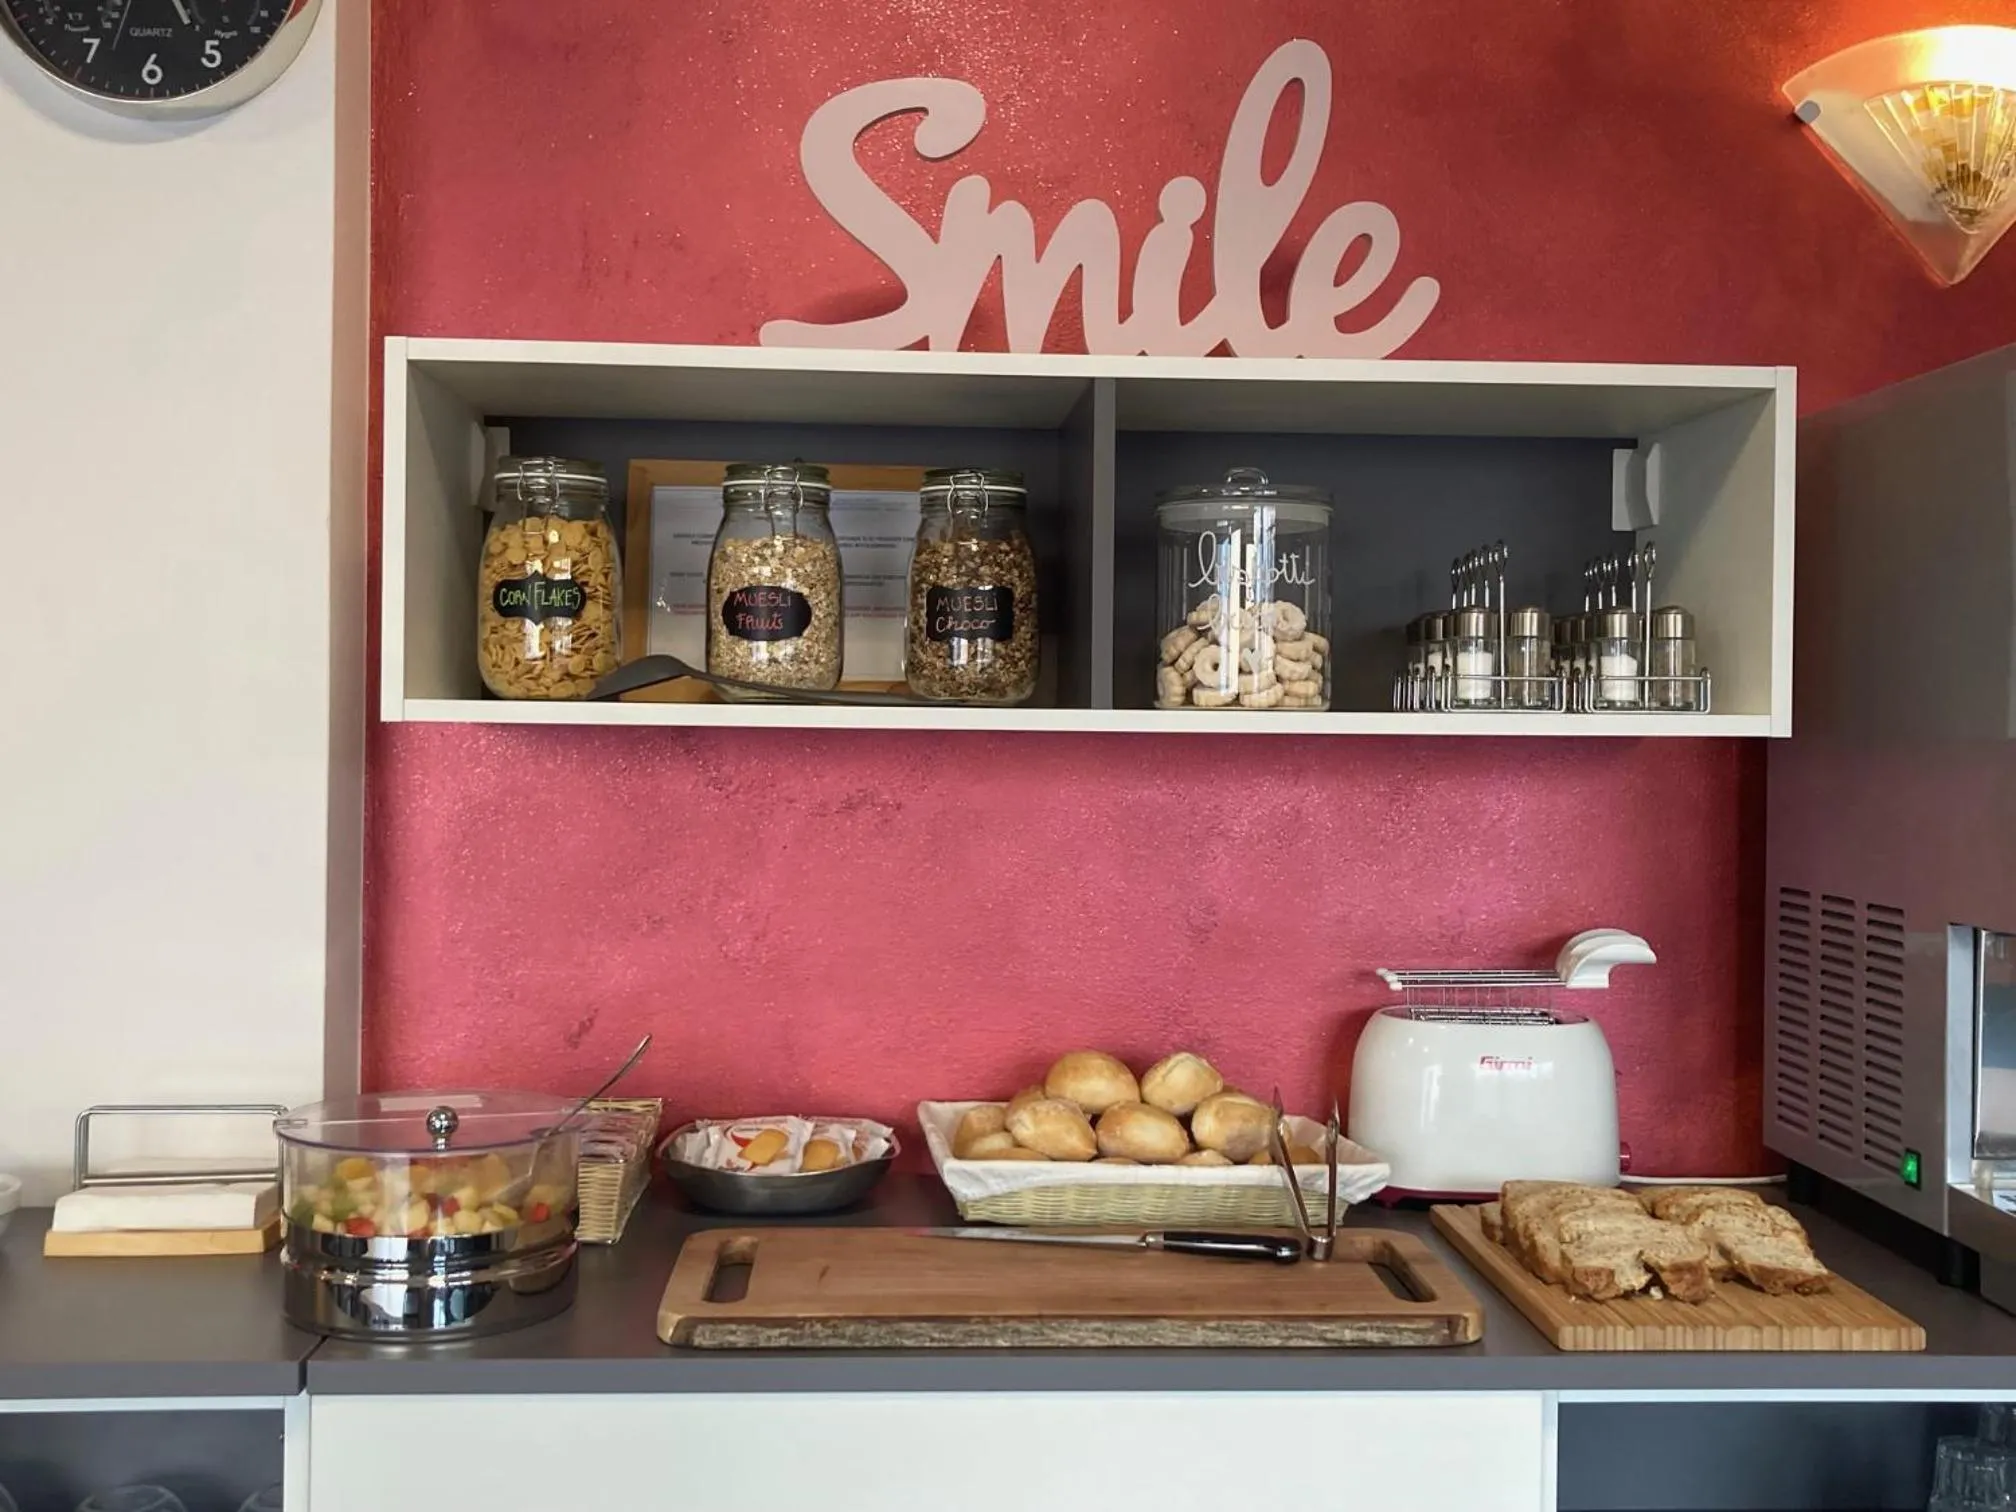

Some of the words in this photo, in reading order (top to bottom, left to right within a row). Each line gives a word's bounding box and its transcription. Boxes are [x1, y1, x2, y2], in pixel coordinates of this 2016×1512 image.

[129, 27, 173, 38] QUARTZ
[82, 38, 101, 63] 7
[201, 40, 222, 68] 5
[141, 53, 163, 85] 6
[759, 39, 1441, 358] Smile
[500, 583, 532, 607] CORN
[534, 581, 581, 610] FLAKES
